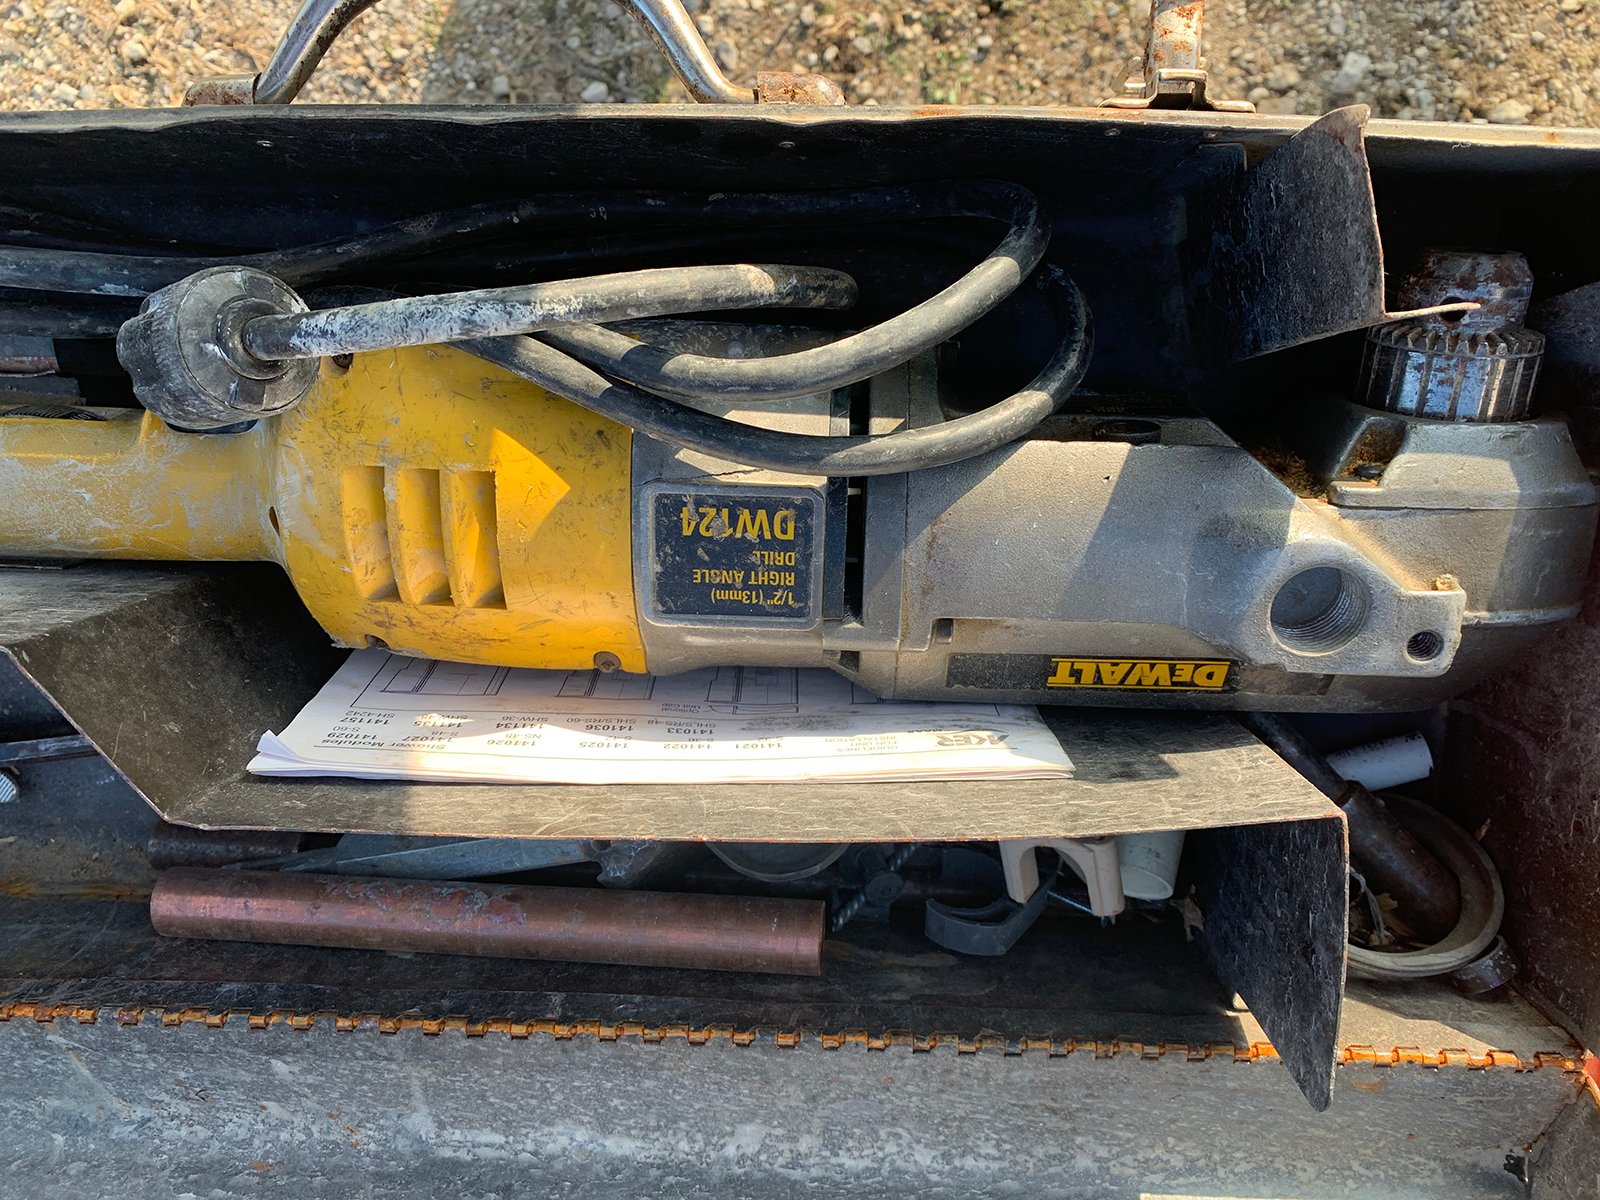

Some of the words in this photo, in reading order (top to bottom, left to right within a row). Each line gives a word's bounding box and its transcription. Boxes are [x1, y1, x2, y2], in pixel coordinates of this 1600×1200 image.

[680, 506, 794, 540] DW124
[752, 550, 796, 566] DRILL
[692, 568, 745, 584] ANGLE
[748, 570, 795, 586] RIGHT
[710, 587, 764, 604] (13mm)
[322, 738, 385, 747] Modules
[327, 732, 378, 740] 141029
